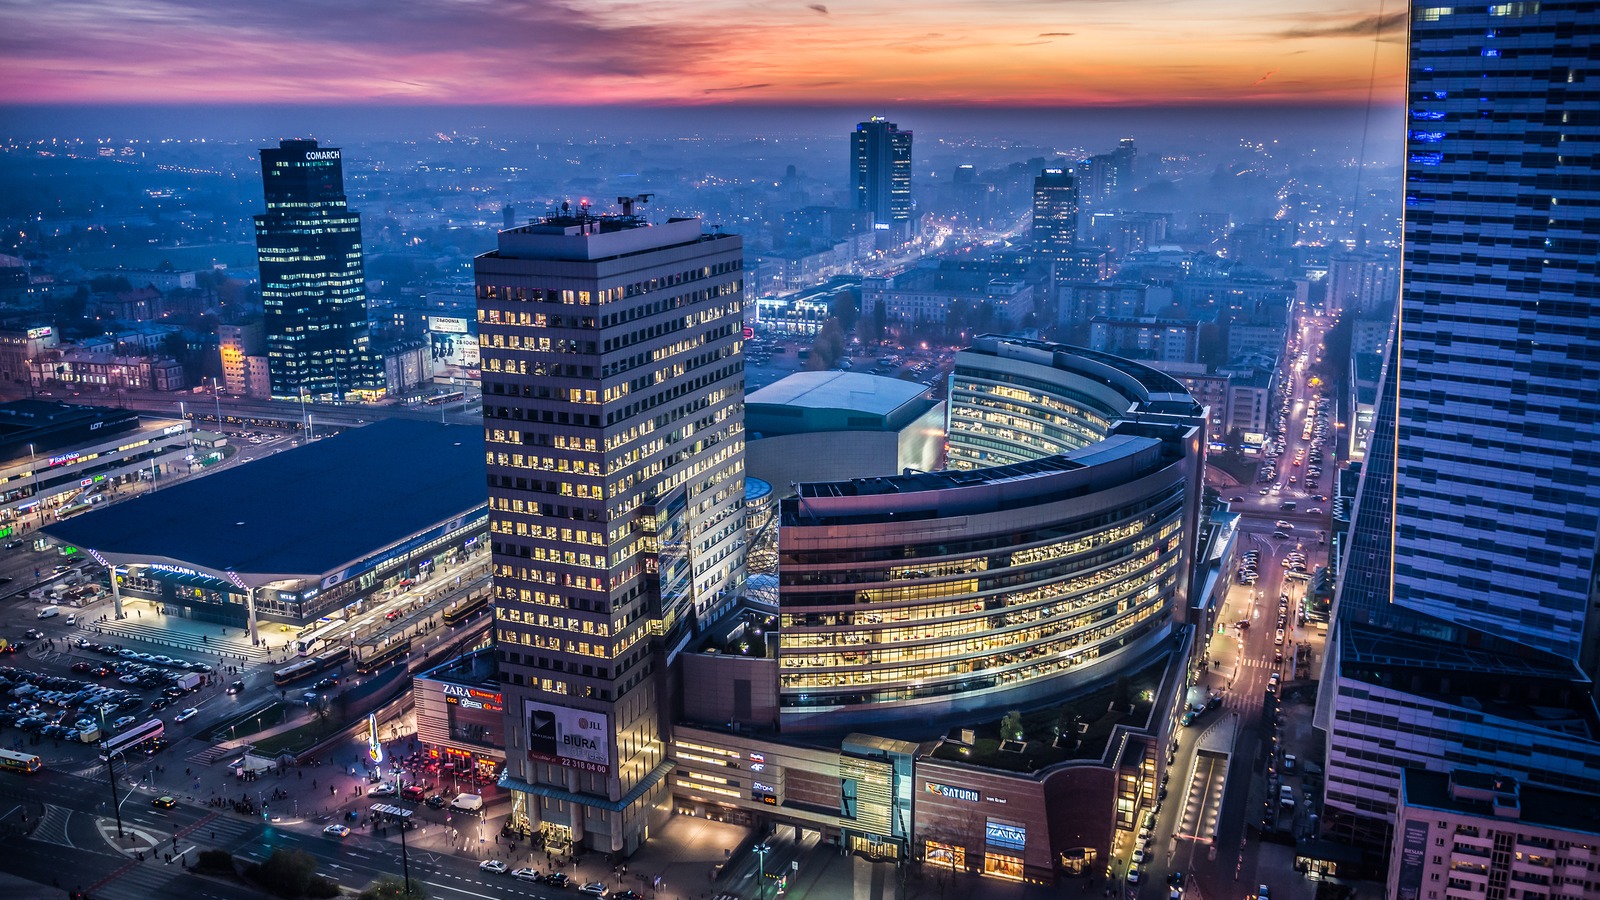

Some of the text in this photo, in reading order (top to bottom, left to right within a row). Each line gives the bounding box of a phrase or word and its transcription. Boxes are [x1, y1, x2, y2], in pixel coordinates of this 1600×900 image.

[306, 151, 340, 160] COMARCH
[90, 421, 104, 430] LOT
[55, 452, 80, 463] Bank Pekao
[151, 563, 196, 576] WARSZAWA
[443, 684, 472, 698] ZARA
[589, 721, 602, 730] JLL
[563, 734, 597, 750] BIURA
[571, 748, 605, 761] OFFICES
[562, 758, 571, 766] 22
[572, 760, 585, 769] 318
[586, 763, 596, 772] 04
[597, 765, 606, 773] 00
[751, 763, 764, 771] 4F
[943, 787, 978, 802] SATURN
